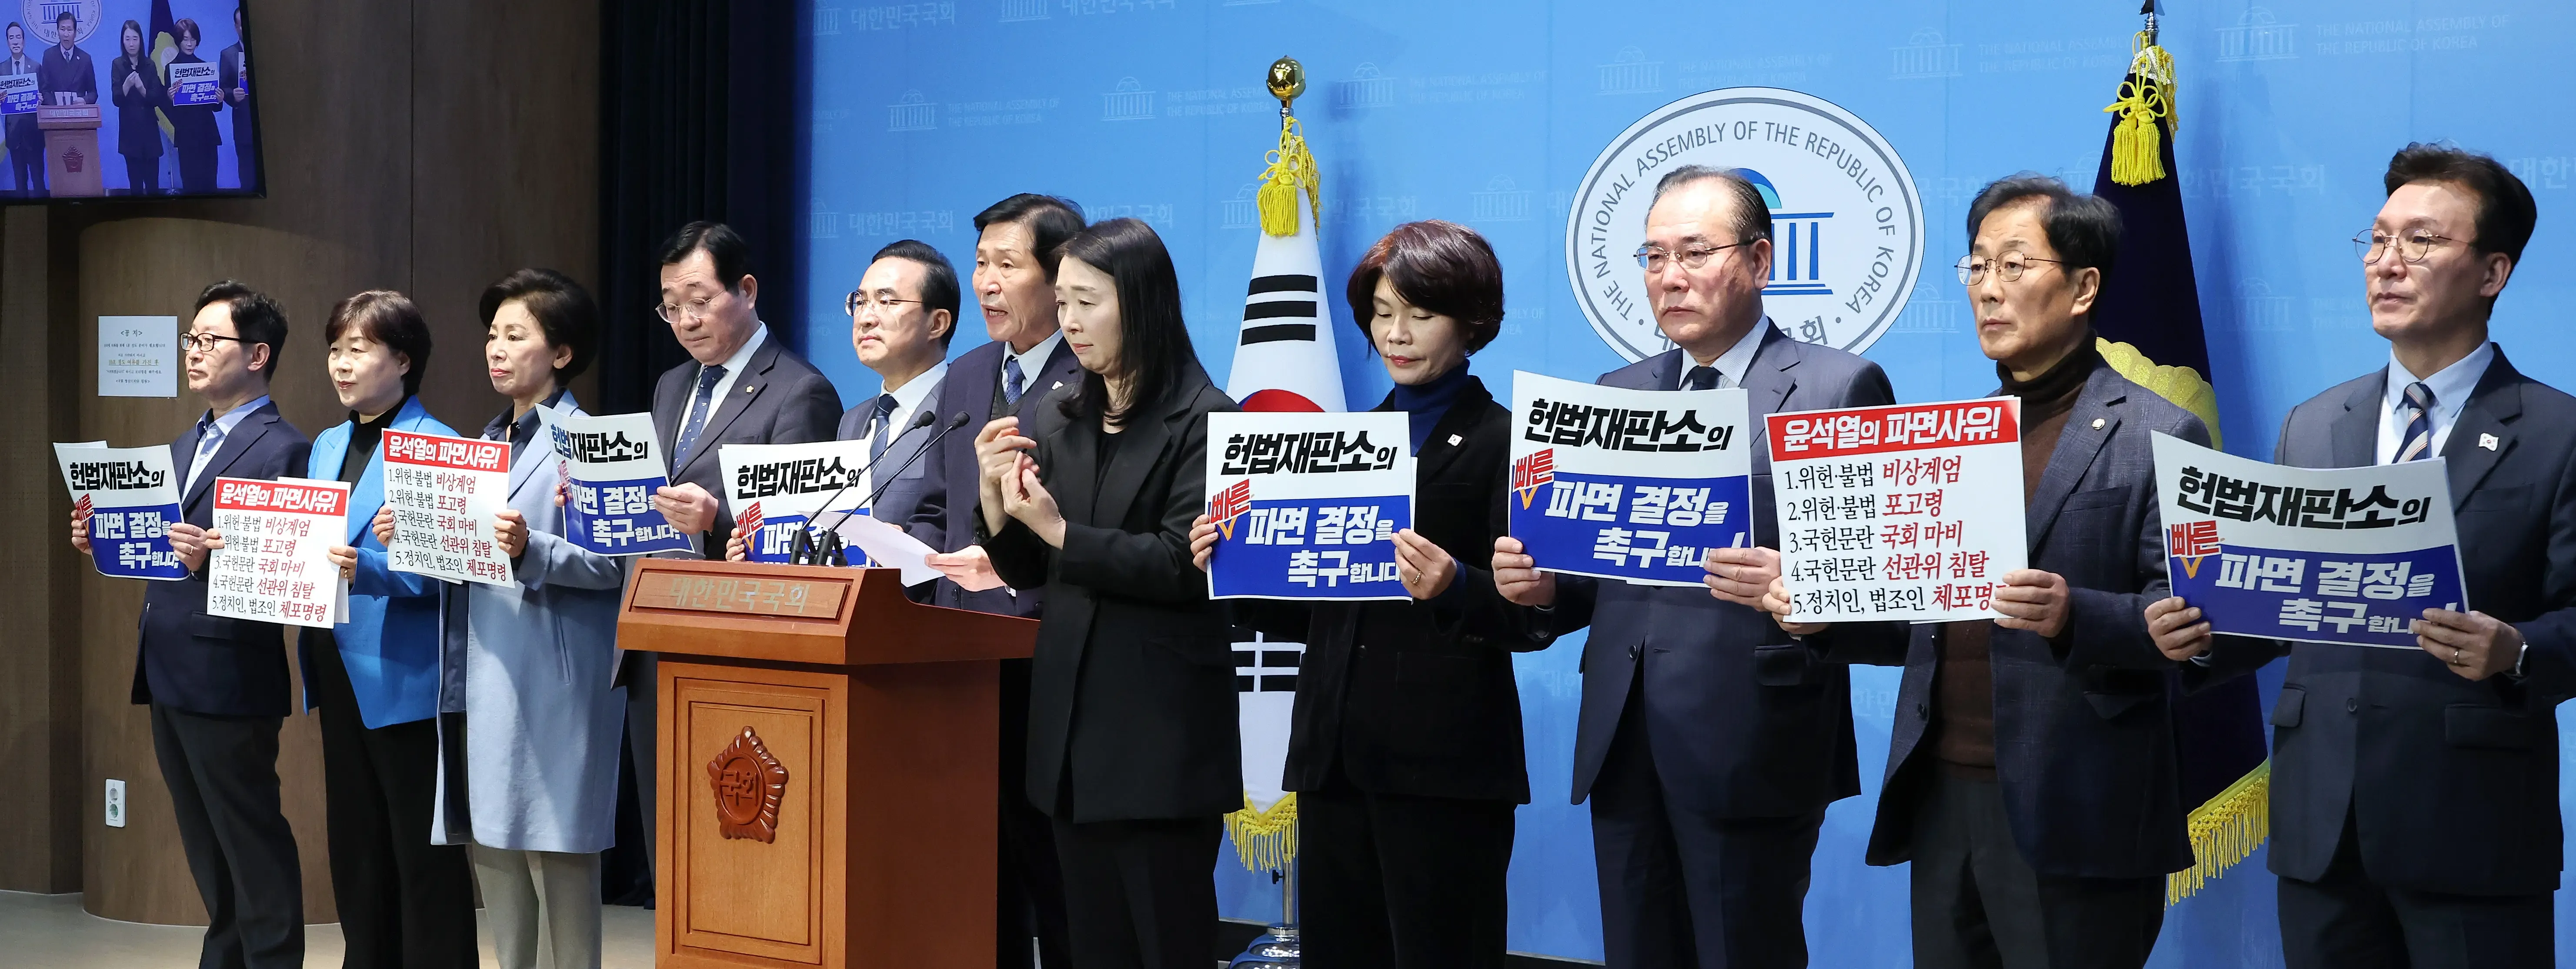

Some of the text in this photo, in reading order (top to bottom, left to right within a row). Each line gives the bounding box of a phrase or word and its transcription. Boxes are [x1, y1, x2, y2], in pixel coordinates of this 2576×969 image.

[851, 1, 955, 30] 대한민국국회
[2316, 14, 2509, 36] THE NATIONAL ASSEMBLY OF
[1979, 36, 2130, 56] THE NATIONAL ASSEMBLY
[2317, 36, 2477, 55] THE REPUBLIC OF KOREA
[175, 67, 215, 78] 헌법재판소의
[1980, 55, 2122, 73] THE REPUBLIC OF KOREA
[0, 78, 35, 90] 헌법재판소의
[7, 94, 19, 103] 파면
[181, 84, 196, 94] 파면
[1167, 87, 1269, 103] THE NATIONAL ASSEMB
[1167, 101, 1271, 117] THE REPUBLIC OF KOREA
[2181, 164, 2325, 198] 한민국국회
[849, 210, 953, 236] 대한민국국회
[1591, 121, 1895, 321] THE NATIONAL ASSEMBLY OF THE REPUBLIC OF KOREA
[1525, 398, 1734, 452] 헌법재판소의
[1783, 406, 2001, 452] 윤석열의 파면사유!
[388, 435, 501, 469] 윤석열의 파면사유!
[551, 424, 648, 463] 헌법재판소의
[1221, 431, 1398, 475] 헌법재판소의
[70, 461, 164, 490] 헌법재판소의
[389, 468, 476, 494] 1.위헌·불법 비상계엄
[737, 456, 861, 499] 헌법재판소의
[1512, 448, 1555, 493] 빠른
[1784, 455, 1962, 490] 1.위헌·불법 비상계엄
[75, 493, 95, 522] 빠른
[220, 483, 339, 513] 윤석열의 파면사유!
[389, 489, 467, 515] 2.위헌·불법 포고령
[571, 484, 656, 515] 파면 결정을
[1211, 478, 1251, 522] 빠른
[1544, 481, 1729, 528] 파면 결정을
[1787, 489, 1943, 522] 2.위헌·불법 포고령
[2177, 465, 2432, 530] 헌법재판소의
[94, 511, 172, 539] 파면 결정을
[218, 514, 311, 537] 1.위헌·불법 비상계엄
[391, 509, 477, 537] 3.국헌문란 국회 마비
[736, 501, 764, 539] 빠른
[1245, 505, 1394, 546] 파면 결정을
[219, 535, 296, 557] 위헌·불법 포고령
[394, 529, 492, 558] 4.국헌문란 선관위 침탈
[1593, 527, 1745, 568] 촉구합니!
[1789, 520, 1962, 553] 3.국헌문란 국회 마비
[2170, 520, 2222, 558] 빠른
[214, 555, 305, 578] 3.국헌문란 국회 마비
[395, 550, 507, 581] 5.정치인, 법조인 체포명령
[1288, 550, 1402, 588] 촉구합니다
[1791, 551, 1990, 583] 4.국헌문란 선관위 침탈
[2215, 553, 2435, 600] 파면 결정을
[213, 575, 315, 599] 4.국헌문란 선관위 침탈
[670, 577, 810, 613] 대한민국국회
[1794, 583, 2010, 615] 5.정치인, 법조인 체포명
[212, 595, 327, 622] 5.정치인, 법조인 체포명령
[2279, 598, 2457, 634] 촉구합니!
[721, 769, 758, 807] 국회
